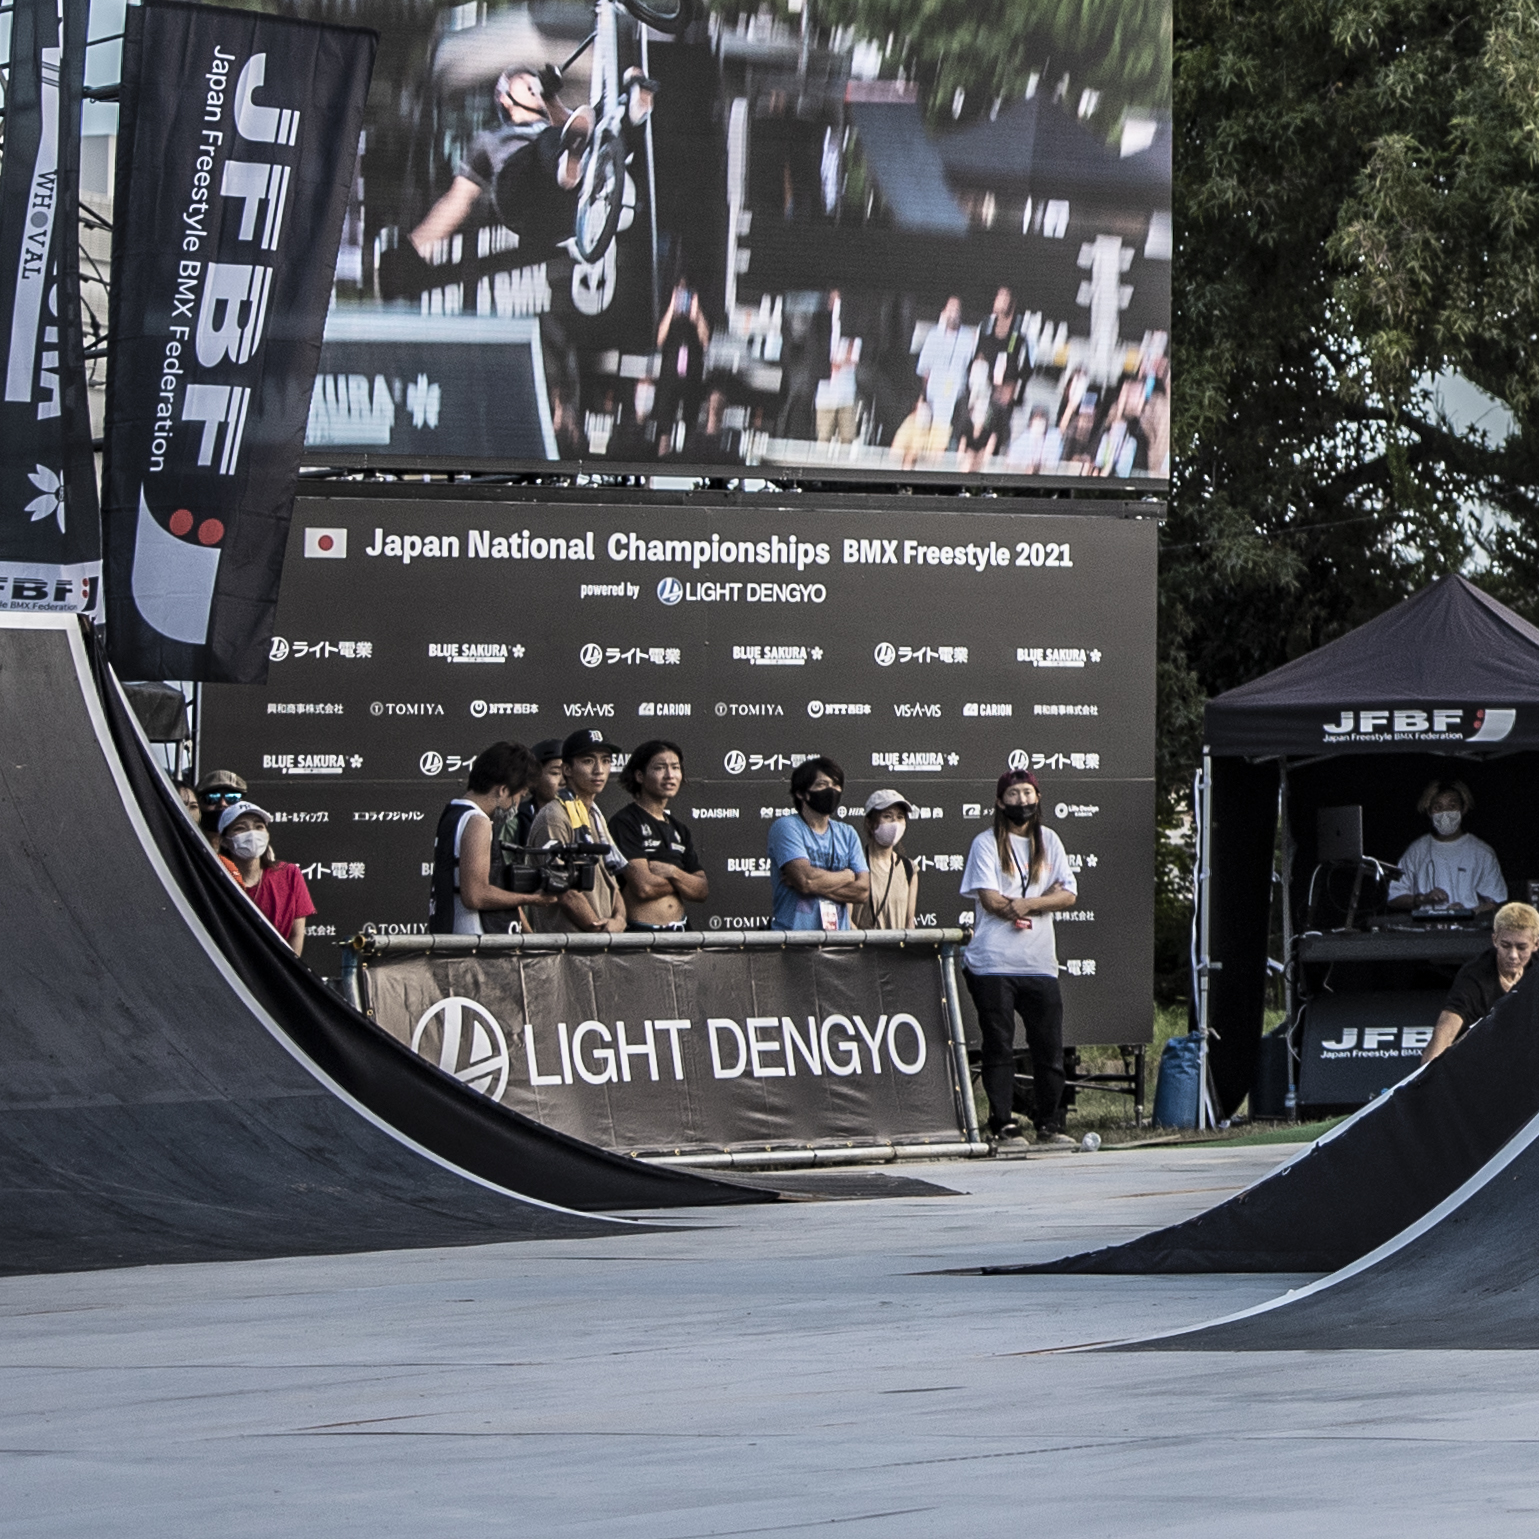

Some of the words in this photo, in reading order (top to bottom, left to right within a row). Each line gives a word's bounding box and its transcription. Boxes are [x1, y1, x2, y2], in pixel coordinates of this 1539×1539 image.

[202, 45, 236, 123] Japan
[182, 129, 223, 252] Freestyle
[181, 52, 300, 476] JFBF
[171, 260, 201, 318] BMX
[149, 325, 189, 473] Federation
[365, 527, 460, 564] Japan
[467, 529, 595, 561] National
[607, 532, 830, 571] Championships
[843, 539, 898, 564] BMX
[904, 540, 1011, 571] Freestyle
[1015, 542, 1073, 568] 2021
[580, 582, 623, 598] powered
[625, 582, 641, 600] by
[685, 584, 742, 602] LIGHT
[746, 583, 827, 603] DENGYO
[10, 601, 31, 610] BMX
[292, 641, 373, 659] ライト電業
[428, 644, 459, 657] BLUE
[462, 644, 508, 657] SAKURA
[605, 648, 681, 665] ライト電業
[732, 646, 761, 659] BLUE
[764, 646, 807, 660] SAKURA
[898, 646, 969, 663] ライト電業
[1017, 648, 1043, 661] BLUE
[1046, 649, 1086, 661] SAKURA
[386, 703, 444, 715] TOMIYA
[656, 703, 691, 717] CARION
[730, 704, 784, 716] TOMIYA
[980, 704, 1012, 717] CARION
[1323, 709, 1464, 734] JFBF
[1323, 733, 1350, 744] Japan
[1351, 731, 1392, 743] Freestyle
[1394, 732, 1413, 740] BMX
[1415, 731, 1463, 741] Federation
[263, 754, 294, 768] BLUE
[297, 754, 345, 768] SAKURA
[871, 752, 899, 766] BLUE
[902, 752, 944, 766] SAKURA
[1031, 753, 1100, 770] ライト電業
[700, 808, 740, 818] DAISHIN
[728, 859, 756, 871] BLUE
[378, 923, 428, 934] TOMIY
[724, 916, 770, 928] TOMIY
[1321, 1025, 1435, 1050] JFB
[524, 1018, 692, 1086] LIGHT
[707, 1012, 927, 1079] DENGYO
[1320, 1050, 1350, 1060] Japan
[1352, 1049, 1399, 1059] Freestyle
[1401, 1048, 1423, 1057] BMX
